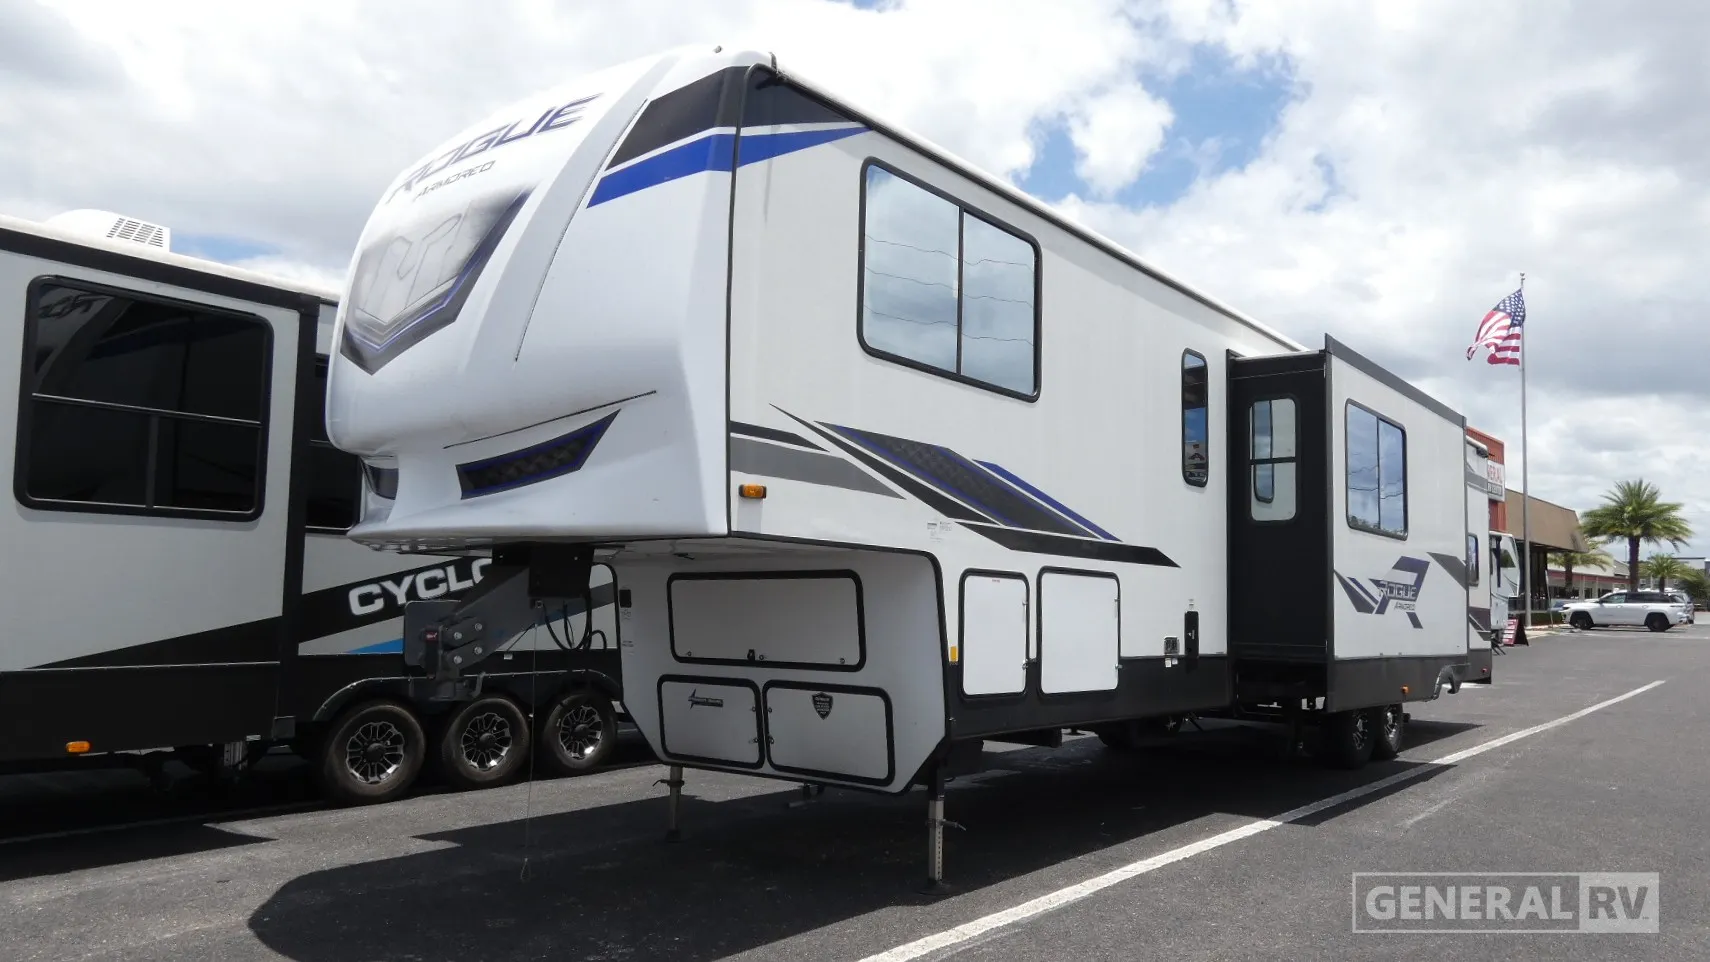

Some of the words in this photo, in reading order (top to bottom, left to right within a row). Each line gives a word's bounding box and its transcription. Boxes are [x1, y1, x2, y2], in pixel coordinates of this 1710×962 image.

[386, 92, 603, 204] ROGUE
[412, 160, 496, 203] ARMORED
[1379, 580, 1417, 600] ROGUE
